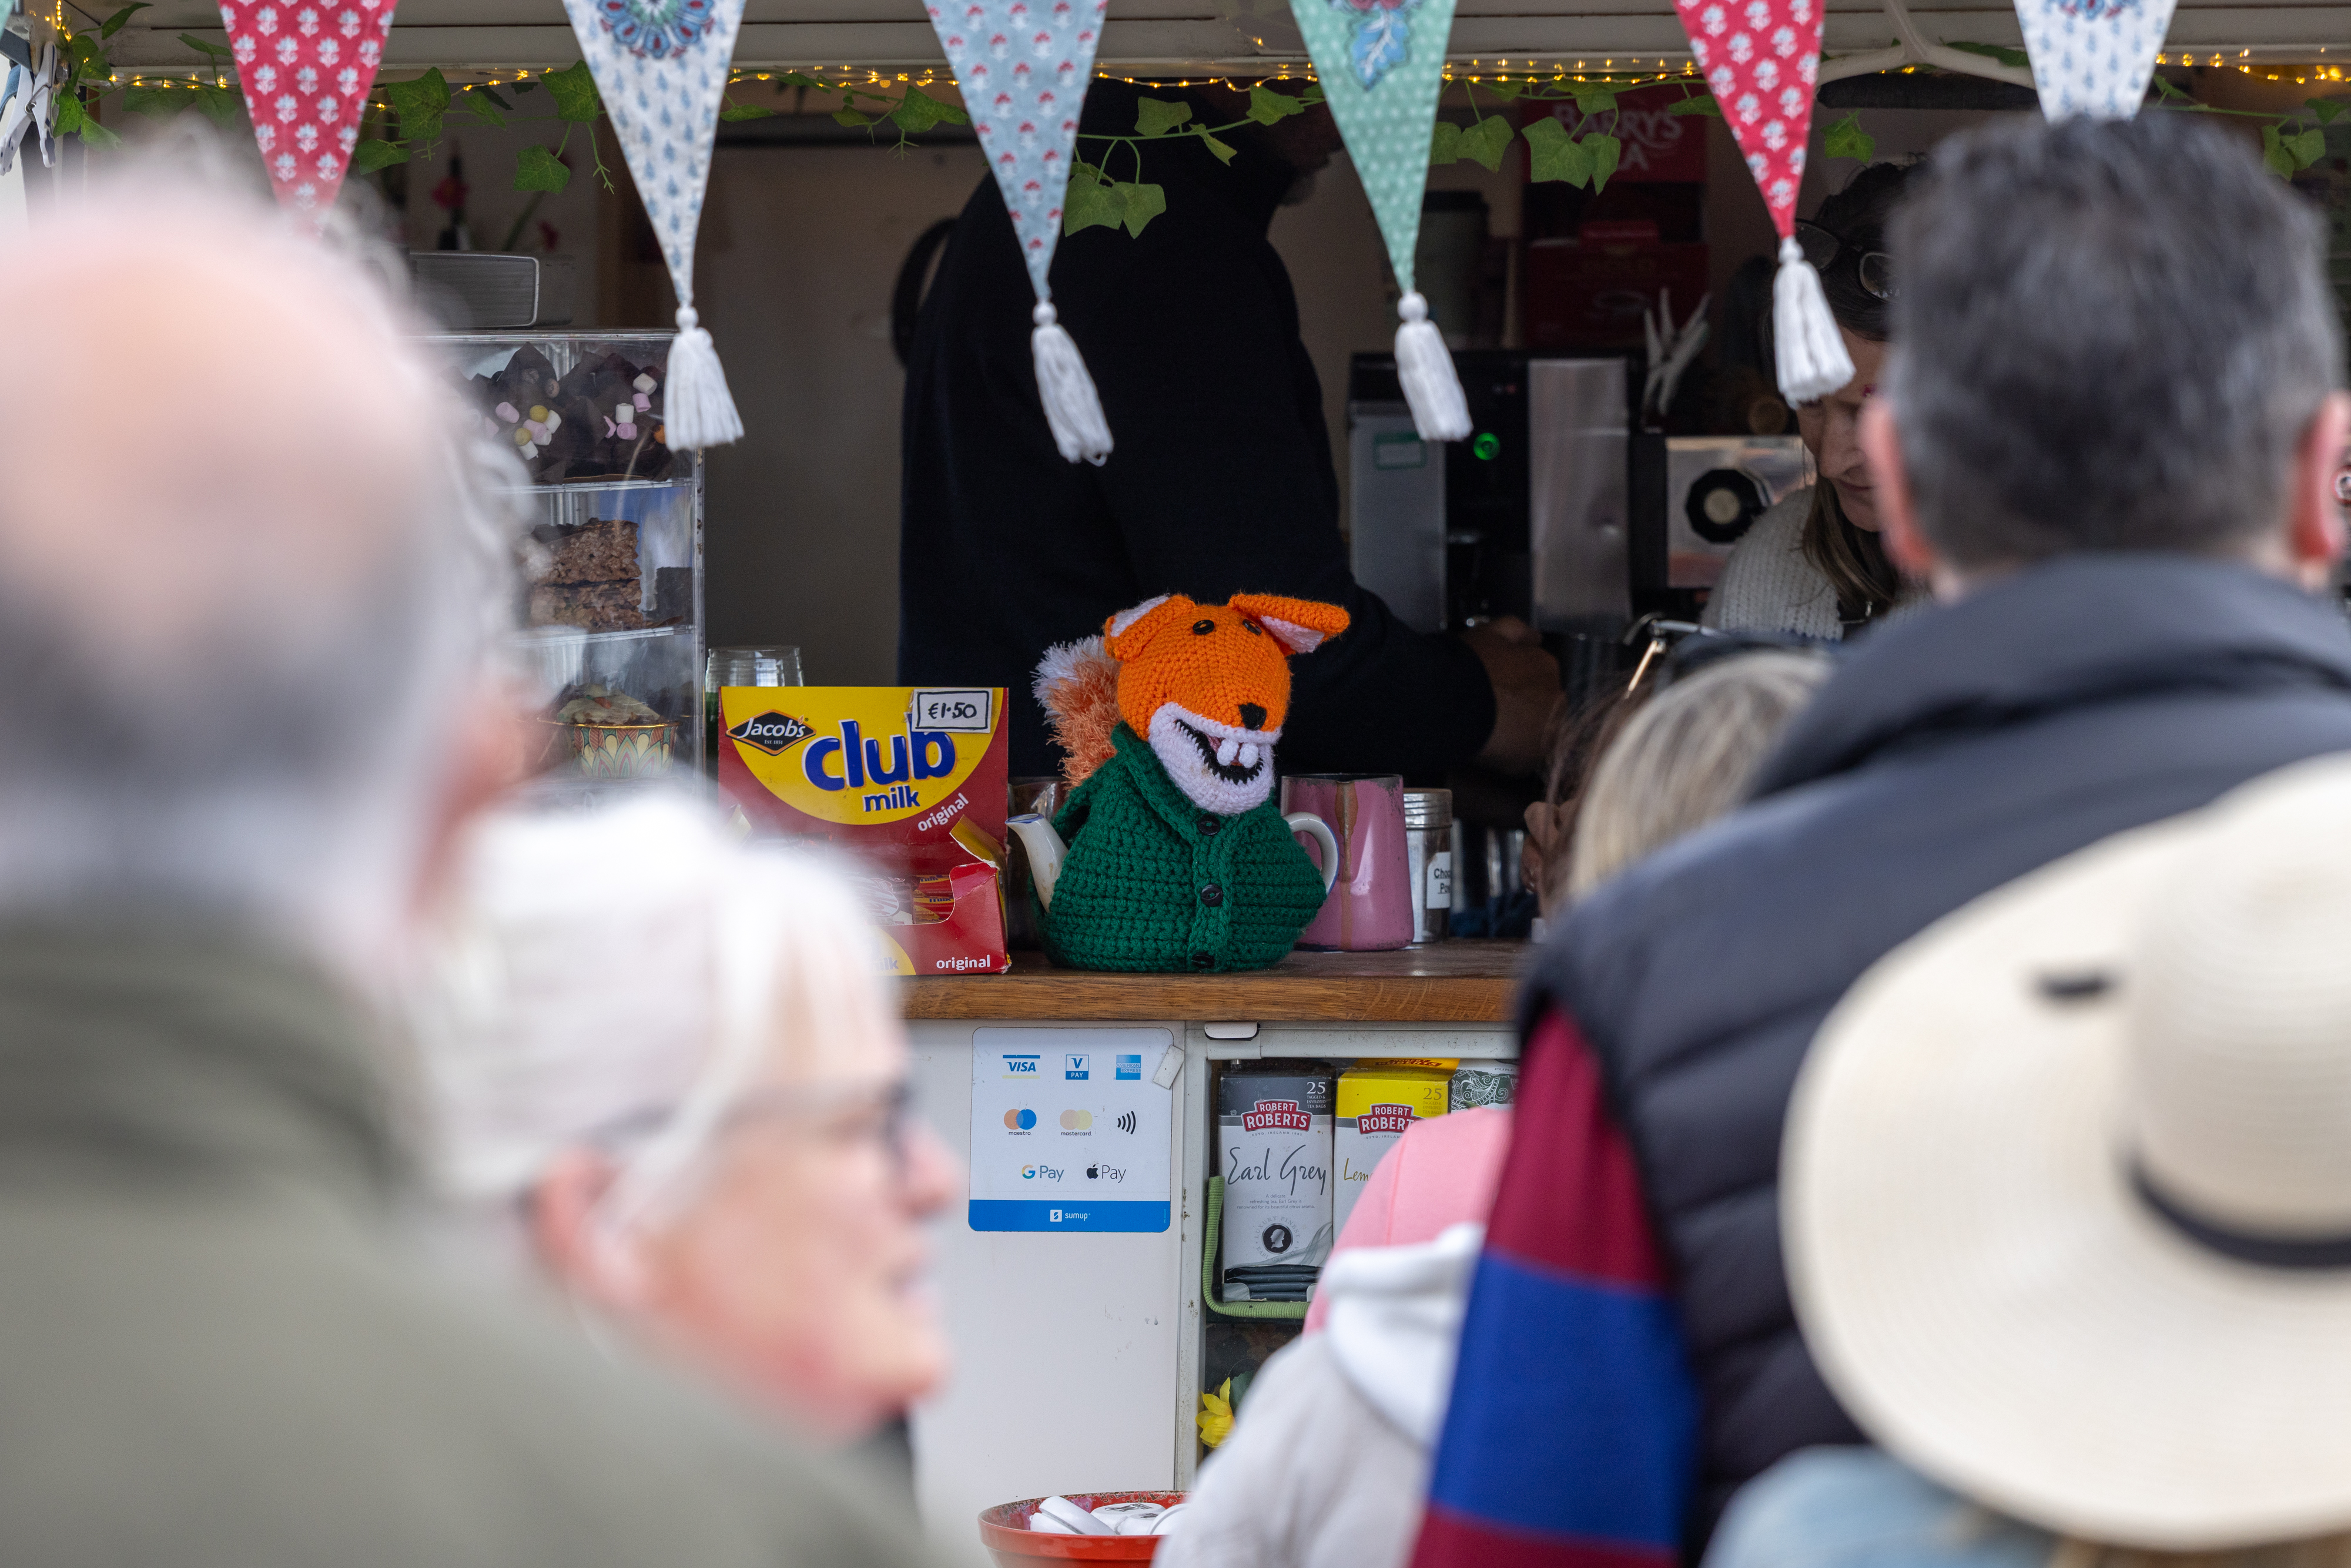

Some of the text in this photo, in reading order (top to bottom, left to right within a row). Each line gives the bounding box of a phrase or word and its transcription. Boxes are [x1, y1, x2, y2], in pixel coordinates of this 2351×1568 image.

[802, 712, 958, 792] club
[862, 785, 921, 812] milk
[917, 792, 969, 832] original
[936, 954, 990, 971] original
[1006, 1061, 1036, 1072] VISA
[1070, 1058, 1083, 1068] V
[1307, 1081, 1326, 1094] 25
[1423, 1087, 1442, 1100] 25
[1260, 1103, 1294, 1112] ROBERT
[1375, 1107, 1409, 1116] ROBERT
[1246, 1113, 1308, 1128] ROBERTS
[1361, 1117, 1414, 1131] ROBERT
[1021, 1164, 1064, 1182] G Pay
[1101, 1165, 1127, 1183] Pay
[1227, 1144, 1326, 1196] Earl Grey
[1064, 1212, 1088, 1221] sumup
[1254, 1215, 1300, 1238] LUXURY FINEST
[1256, 1246, 1268, 1259] EARL
